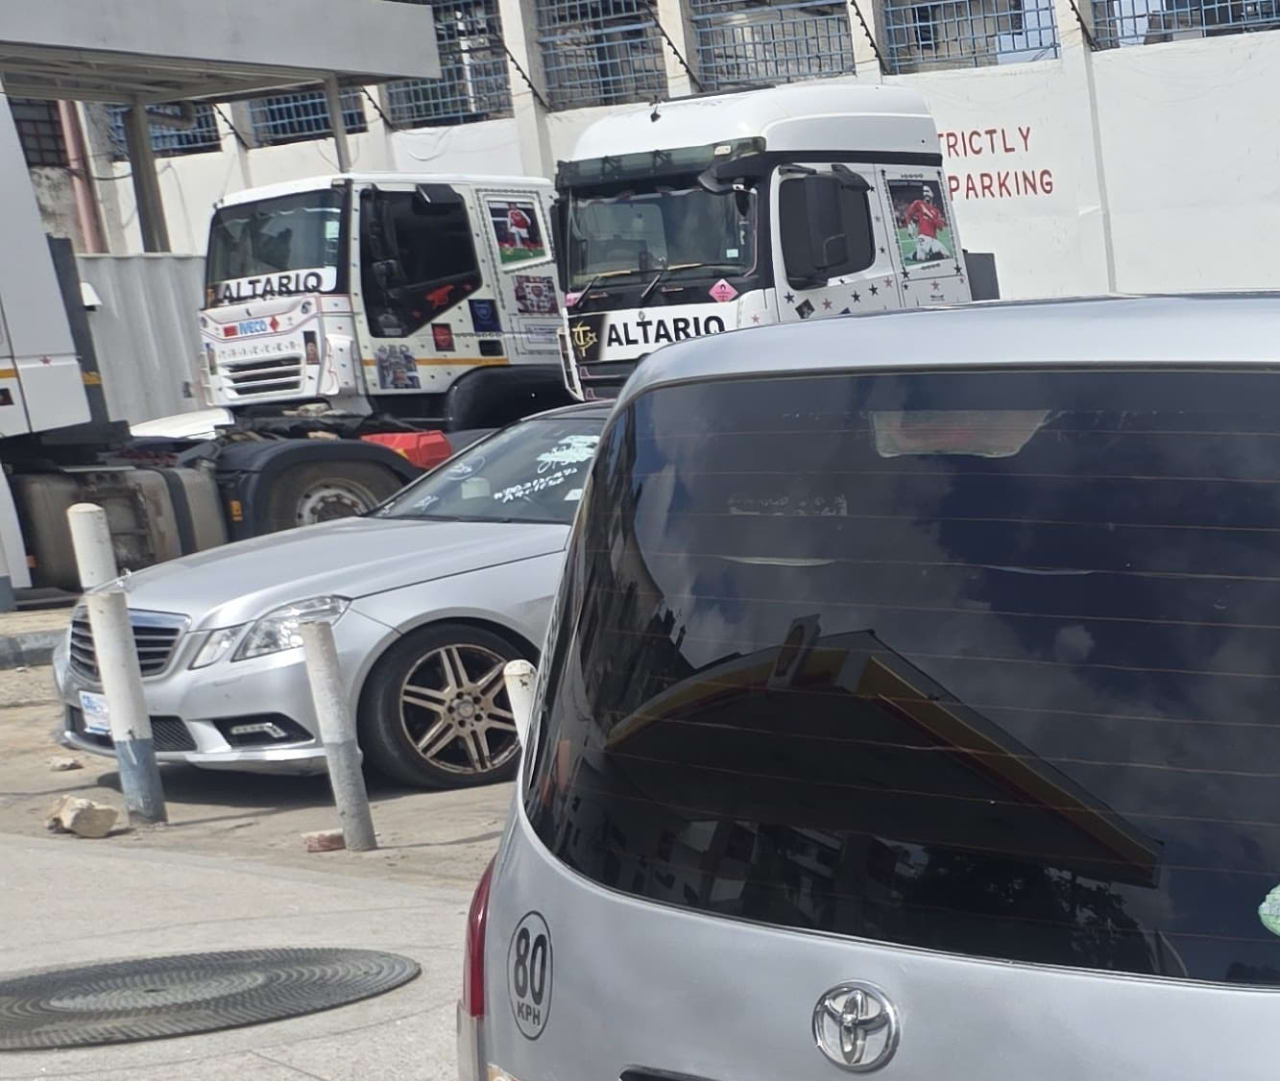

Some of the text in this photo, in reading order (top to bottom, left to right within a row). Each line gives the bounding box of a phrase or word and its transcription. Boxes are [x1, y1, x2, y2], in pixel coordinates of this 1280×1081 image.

[937, 126, 1031, 158] TRICTLY
[947, 169, 1053, 201] PARKING
[222, 271, 322, 302] ALTARIQ
[513, 927, 549, 1004] 80
[516, 1003, 542, 1027] KPH
